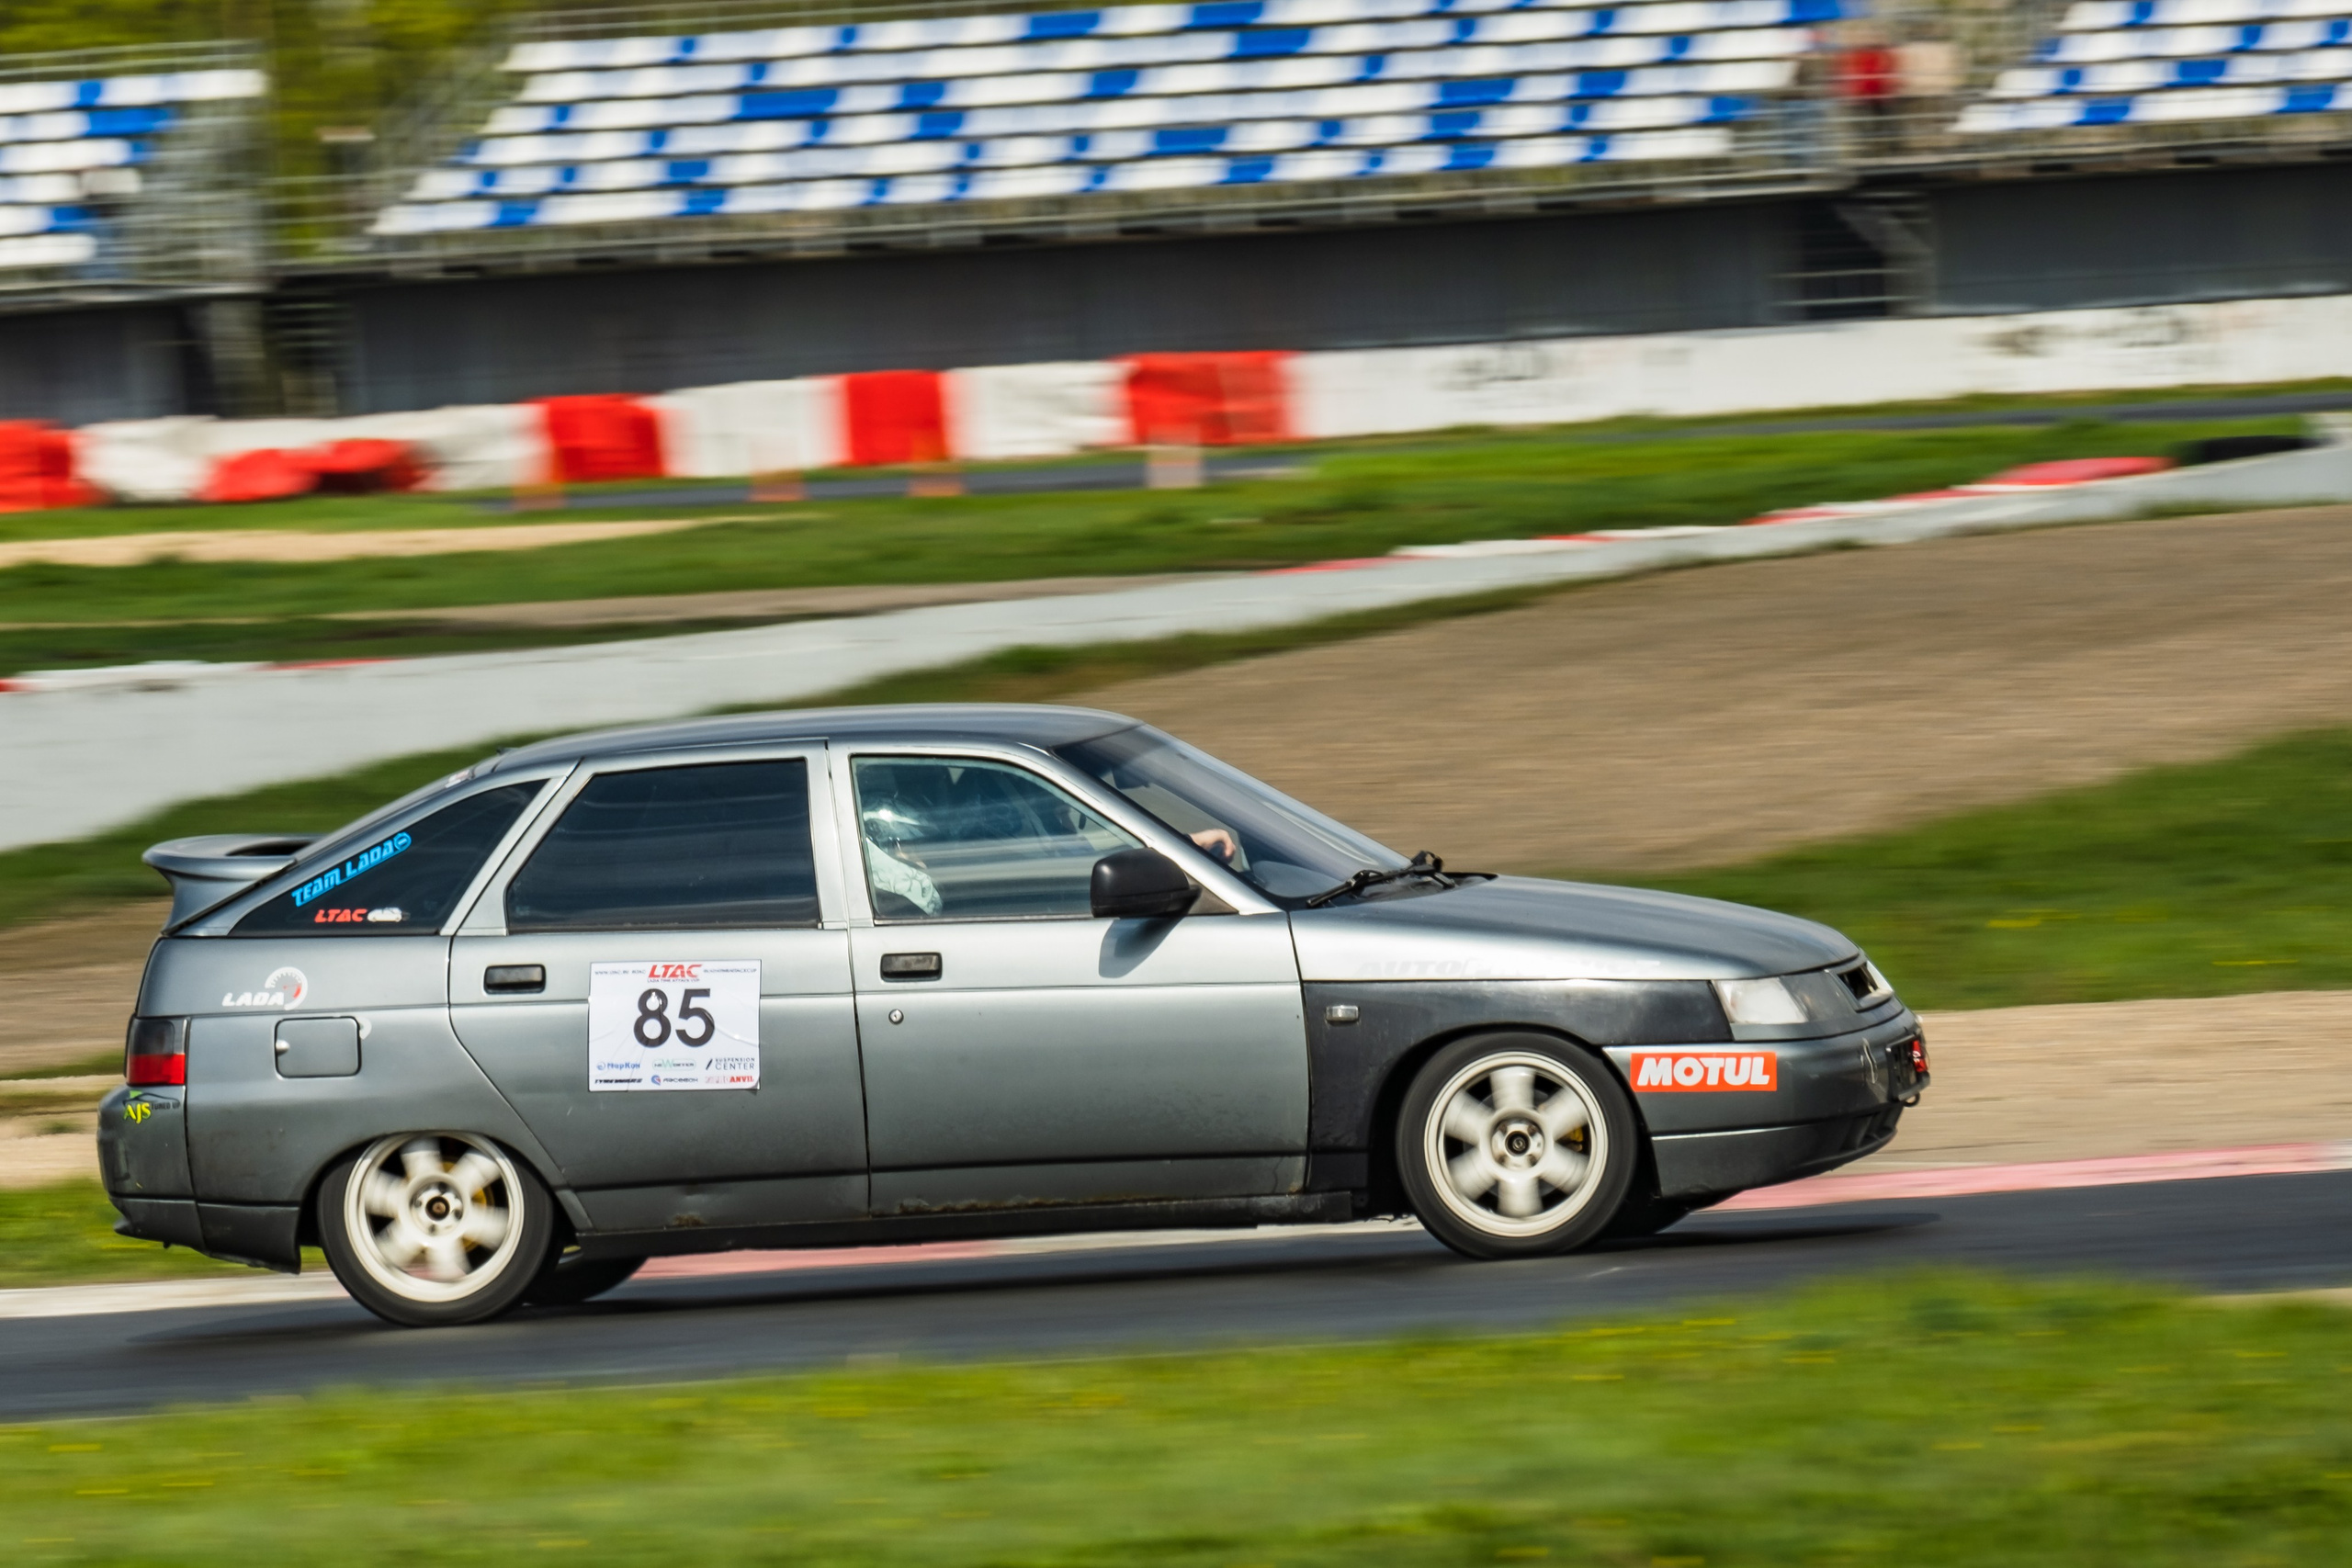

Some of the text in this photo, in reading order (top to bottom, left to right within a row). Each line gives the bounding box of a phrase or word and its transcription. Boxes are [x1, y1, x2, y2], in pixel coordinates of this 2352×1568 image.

[291, 839, 396, 908] TEAM LADA
[314, 908, 368, 923] LTAC
[648, 964, 704, 978] LTAC
[221, 992, 286, 1008] LADA
[633, 987, 716, 1048] 85
[1636, 1056, 1770, 1087] MOTUL
[123, 1101, 152, 1124] AJS
[151, 1101, 172, 1111] TUNED
